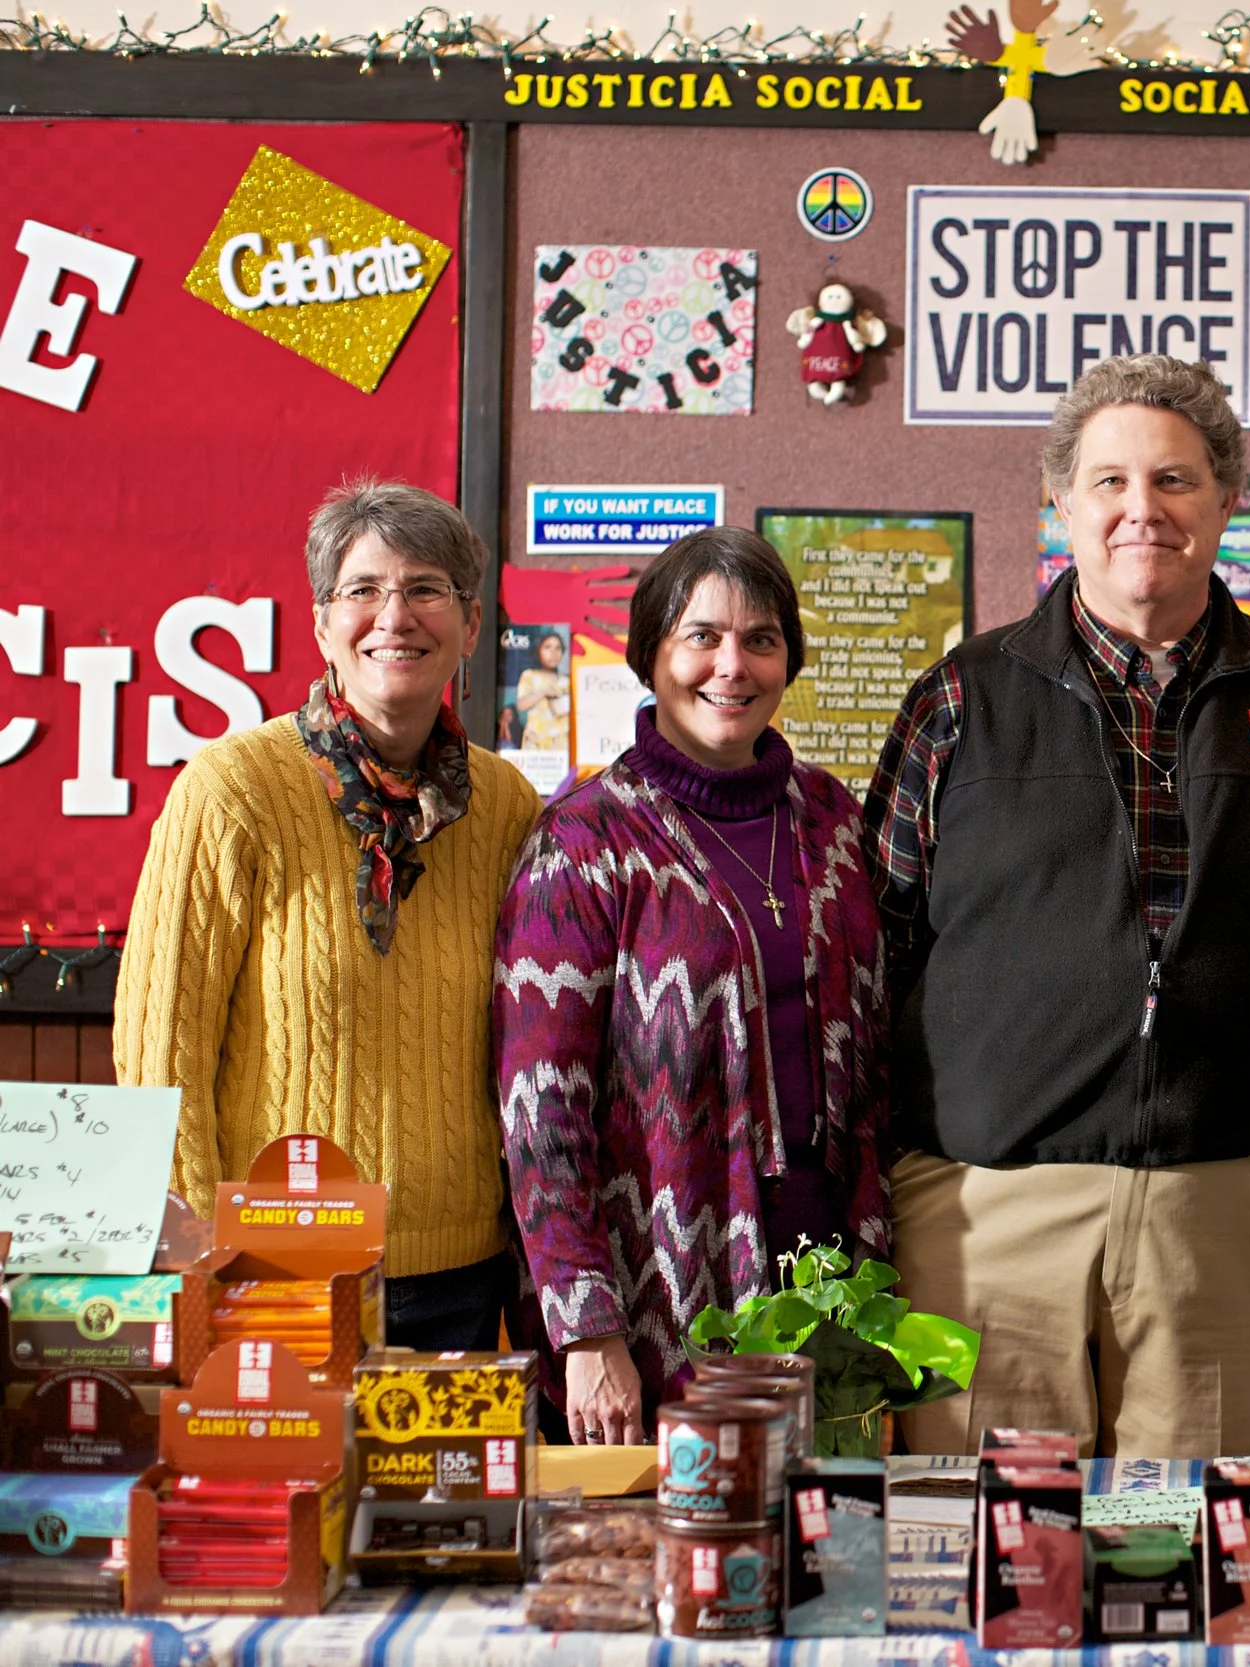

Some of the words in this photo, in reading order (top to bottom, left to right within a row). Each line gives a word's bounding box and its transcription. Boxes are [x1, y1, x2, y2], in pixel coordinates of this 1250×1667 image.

[505, 73, 732, 110] JUSTICIA
[756, 74, 923, 112] SOCIAL
[930, 217, 1103, 299] STOP
[1114, 220, 1234, 302] THE
[218, 231, 427, 312] Celebrate
[543, 499, 559, 514] IF
[563, 499, 597, 514] YOU
[601, 499, 650, 514] WANT
[653, 499, 706, 515] PEACE
[543, 525, 595, 540] WORK
[598, 525, 632, 540] FOR
[635, 524, 706, 540] JUSTIC
[803, 546, 828, 563] First
[829, 547, 854, 565] they
[856, 551, 886, 563] came
[888, 548, 905, 563] for
[907, 549, 926, 563] the
[800, 578, 822, 592] and
[824, 578, 830, 592] I
[831, 578, 851, 593] did
[853, 581, 872, 594] not
[874, 579, 905, 595] speak
[907, 582, 929, 595] out
[814, 593, 856, 609] because
[858, 593, 865, 608] I
[866, 596, 887, 609] was
[889, 596, 908, 609] not
[826, 613, 834, 623] a
[829, 635, 855, 649] they
[857, 638, 886, 649] came
[888, 634, 905, 649] for
[907, 634, 927, 650] the
[821, 649, 850, 663] trade
[822, 664, 827, 678] I
[829, 664, 848, 678] did
[850, 667, 870, 679] not
[872, 665, 902, 681] speak
[814, 679, 856, 693] because
[858, 679, 864, 693] I
[866, 683, 887, 694] was
[826, 695, 856, 709] trade
[782, 717, 811, 732] Then
[812, 719, 837, 734] they
[839, 722, 869, 734] came
[871, 719, 888, 734] for
[797, 734, 818, 748] and
[820, 734, 826, 748] I
[828, 734, 847, 748] did
[848, 736, 869, 748] not
[839, 749, 845, 763] I
[847, 752, 868, 764] was
[249, 1199, 286, 1208] ORGANIC
[239, 1209, 298, 1225] CANDY
[315, 1209, 365, 1226] BARS
[187, 1419, 249, 1437] CANDY
[268, 1420, 321, 1438] BARS
[367, 1452, 434, 1473] DARK
[442, 1451, 479, 1471] 55%
[367, 1474, 435, 1485] CHOCOLATE
